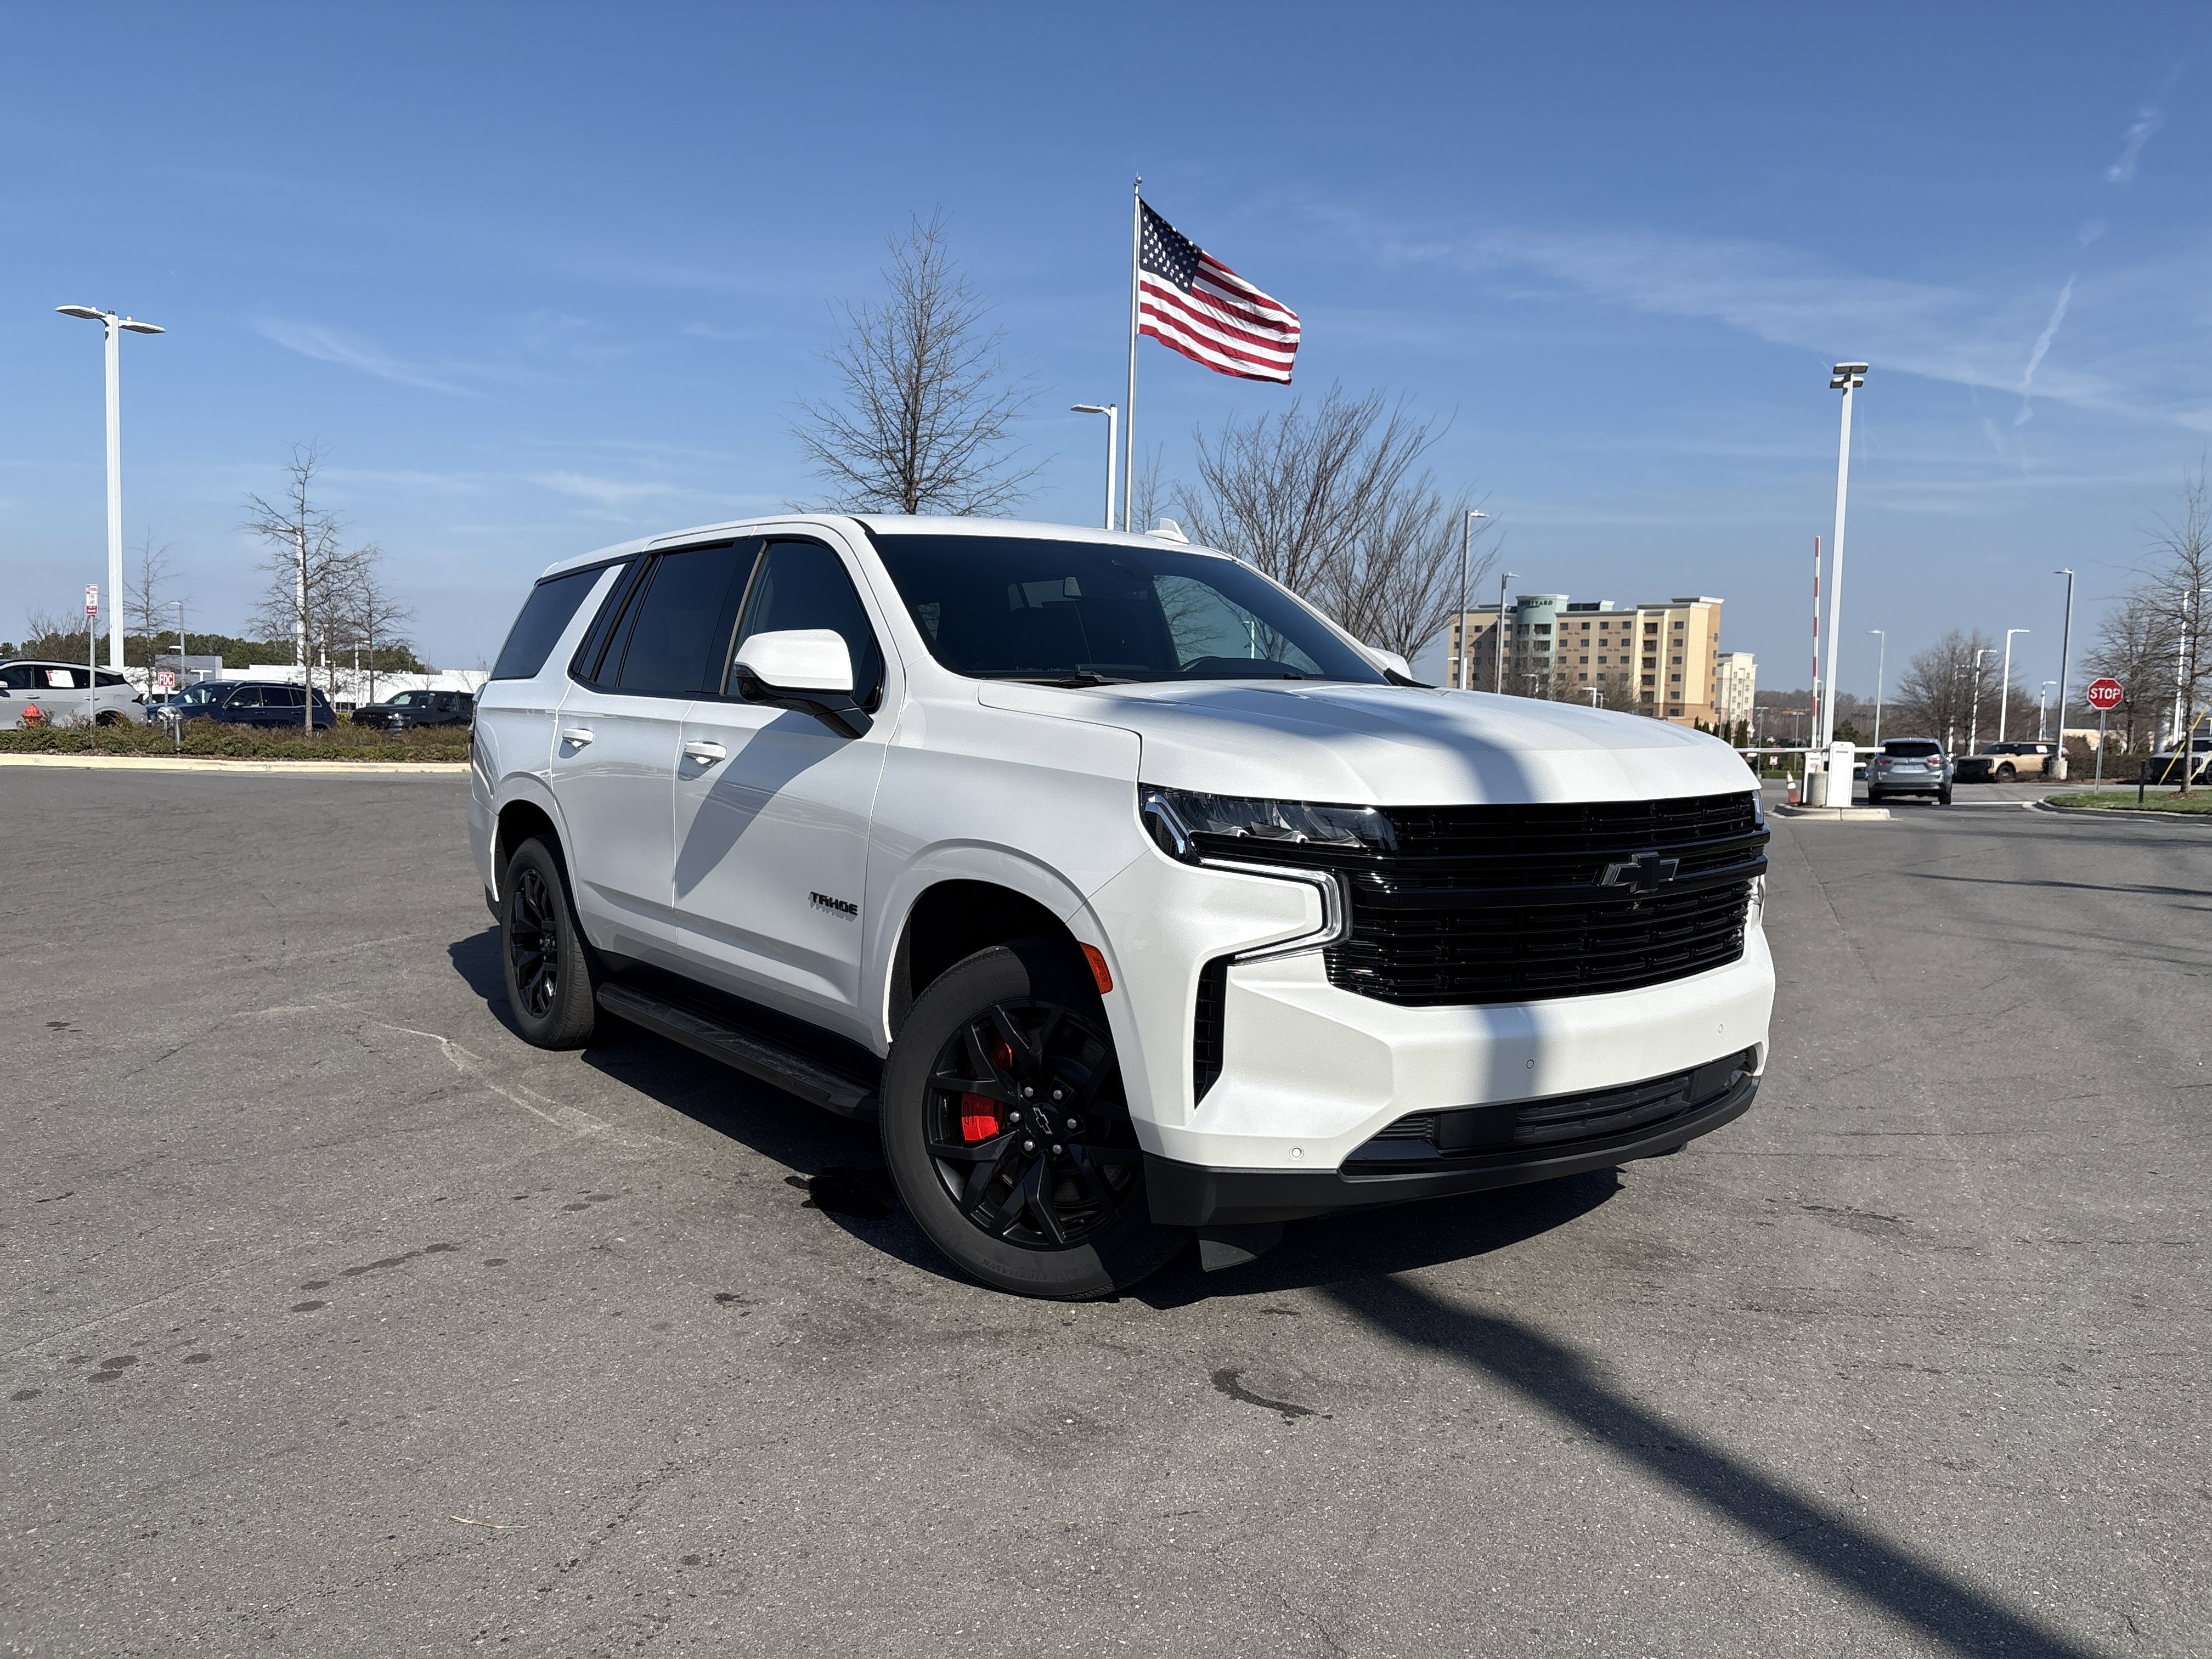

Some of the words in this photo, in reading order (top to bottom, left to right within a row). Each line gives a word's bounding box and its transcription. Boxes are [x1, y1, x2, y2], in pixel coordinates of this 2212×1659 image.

[159, 674, 173, 685] FDC
[2090, 687, 2121, 700] STOP
[810, 891, 858, 916] TAHOE
[980, 1258, 1047, 1280] FIREHAWK
